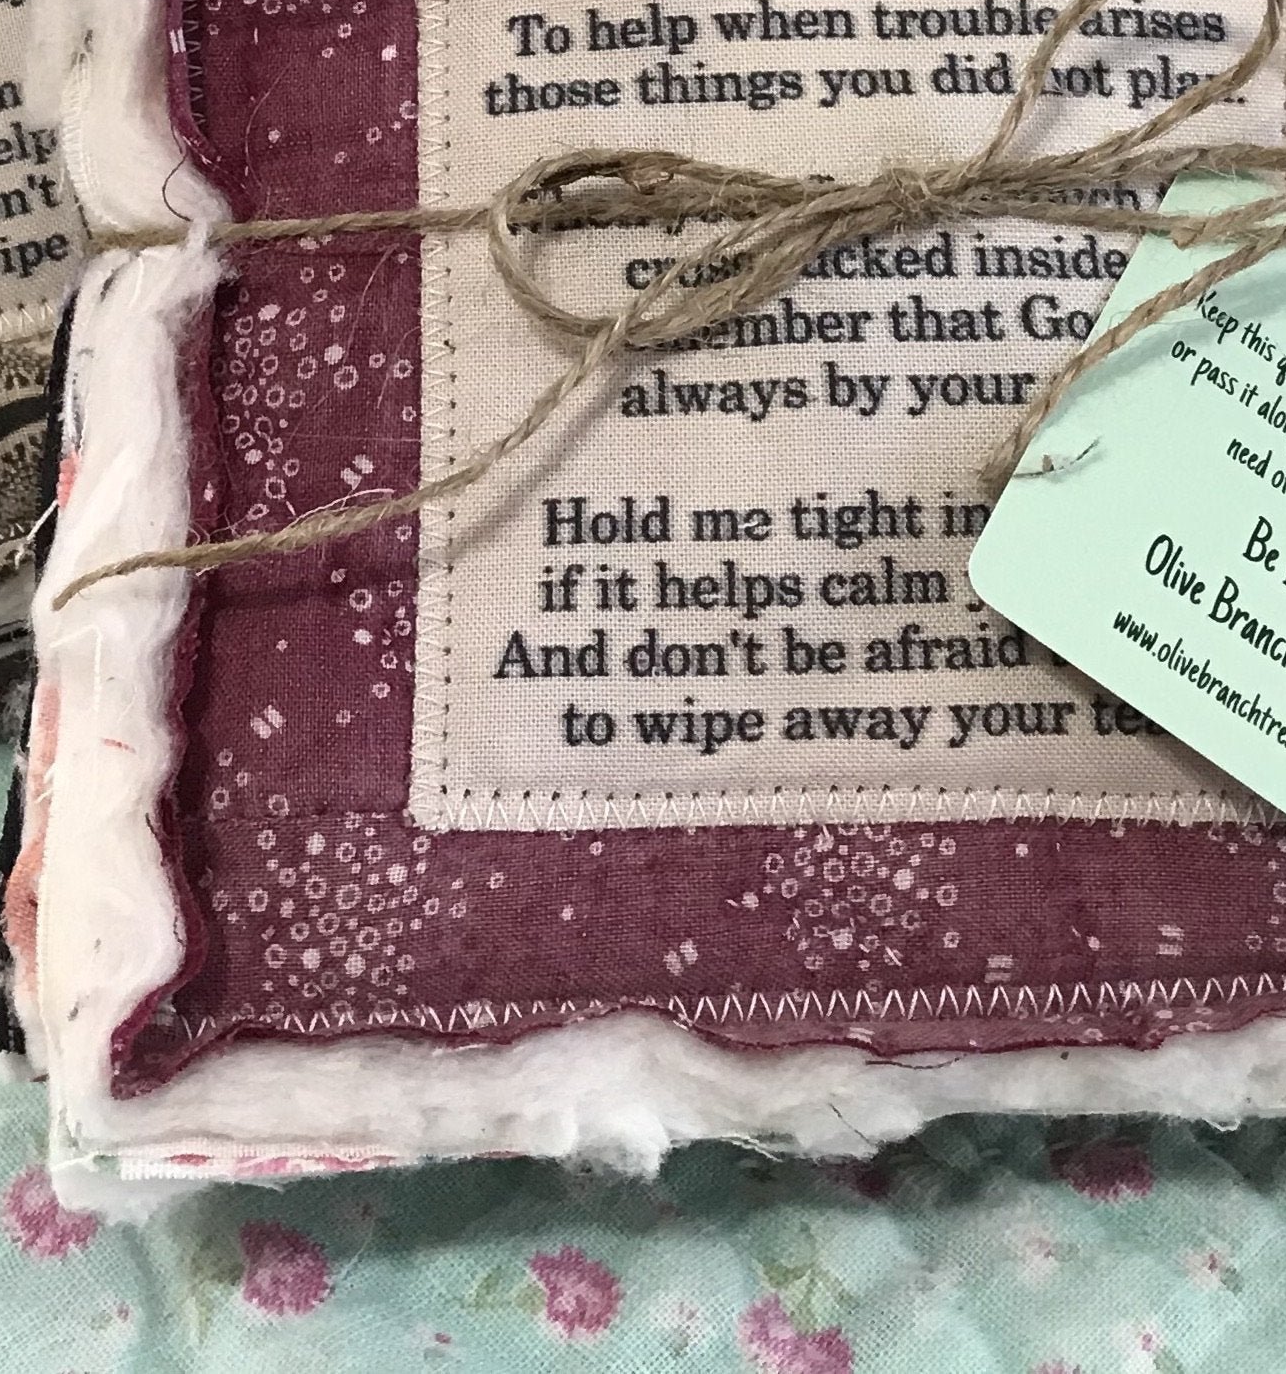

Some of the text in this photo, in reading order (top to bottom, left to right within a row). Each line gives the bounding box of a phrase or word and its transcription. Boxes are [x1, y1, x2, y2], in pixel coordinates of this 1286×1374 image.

[507, 12, 570, 57] To
[586, 3, 698, 55] help
[485, 72, 620, 115] those
[636, 62, 803, 110] things
[819, 67, 915, 108] you
[931, 52, 1014, 95] did
[974, 231, 1128, 279] inside
[888, 295, 1004, 342] that
[1019, 293, 1097, 341] Go
[1241, 322, 1276, 361] this
[621, 361, 1036, 422] always by your
[1171, 341, 1196, 362] or
[1190, 357, 1238, 395] pass
[1239, 383, 1258, 407] it
[1226, 438, 1272, 478] need
[543, 496, 672, 546] Hold
[692, 508, 773, 541] me
[791, 488, 924, 549] tight
[1242, 516, 1280, 572] Be
[539, 556, 949, 620] if it helps calm
[1145, 534, 1205, 604] Olive
[493, 622, 1031, 678] And don't be afraid
[563, 702, 615, 746] to
[633, 695, 765, 755] wipe
[784, 705, 931, 749] away
[947, 701, 1075, 748] your
